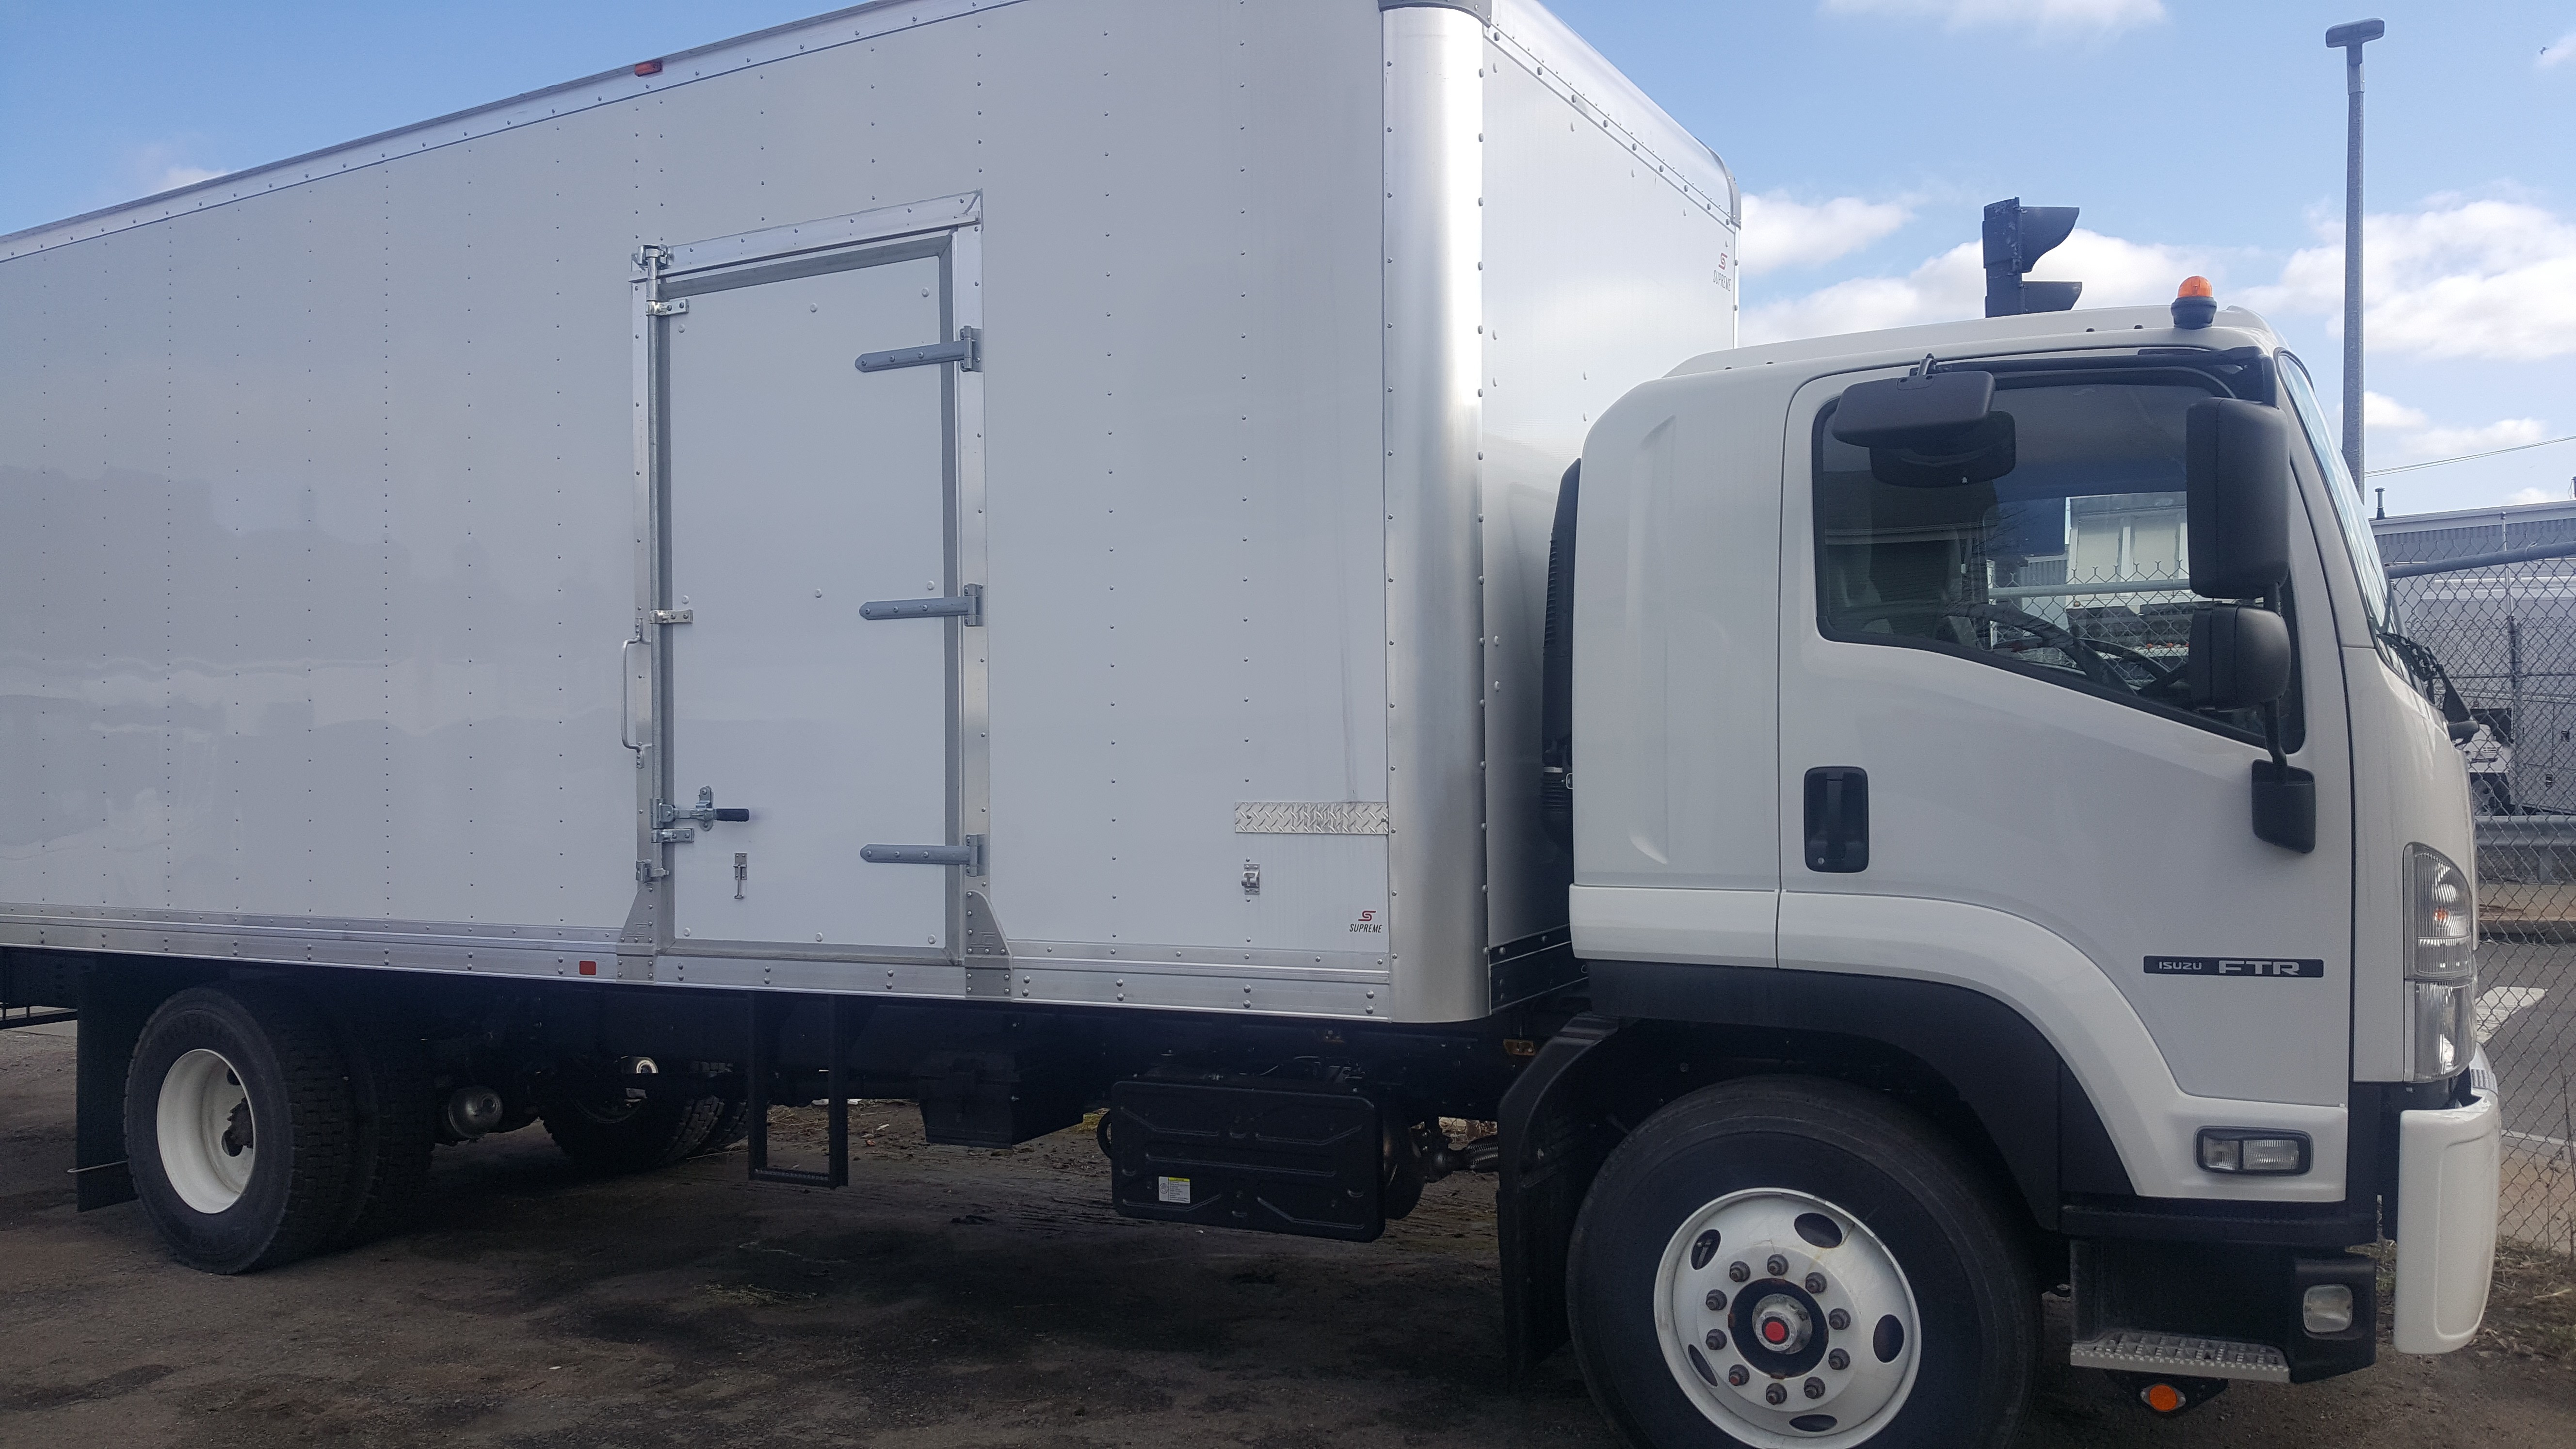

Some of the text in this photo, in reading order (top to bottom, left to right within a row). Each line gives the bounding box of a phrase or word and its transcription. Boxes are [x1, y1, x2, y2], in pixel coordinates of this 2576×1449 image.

[1713, 270, 1731, 291] SUPREME
[1349, 923, 1383, 933] SUPREME
[2158, 960, 2300, 976] ISUZU FTR
